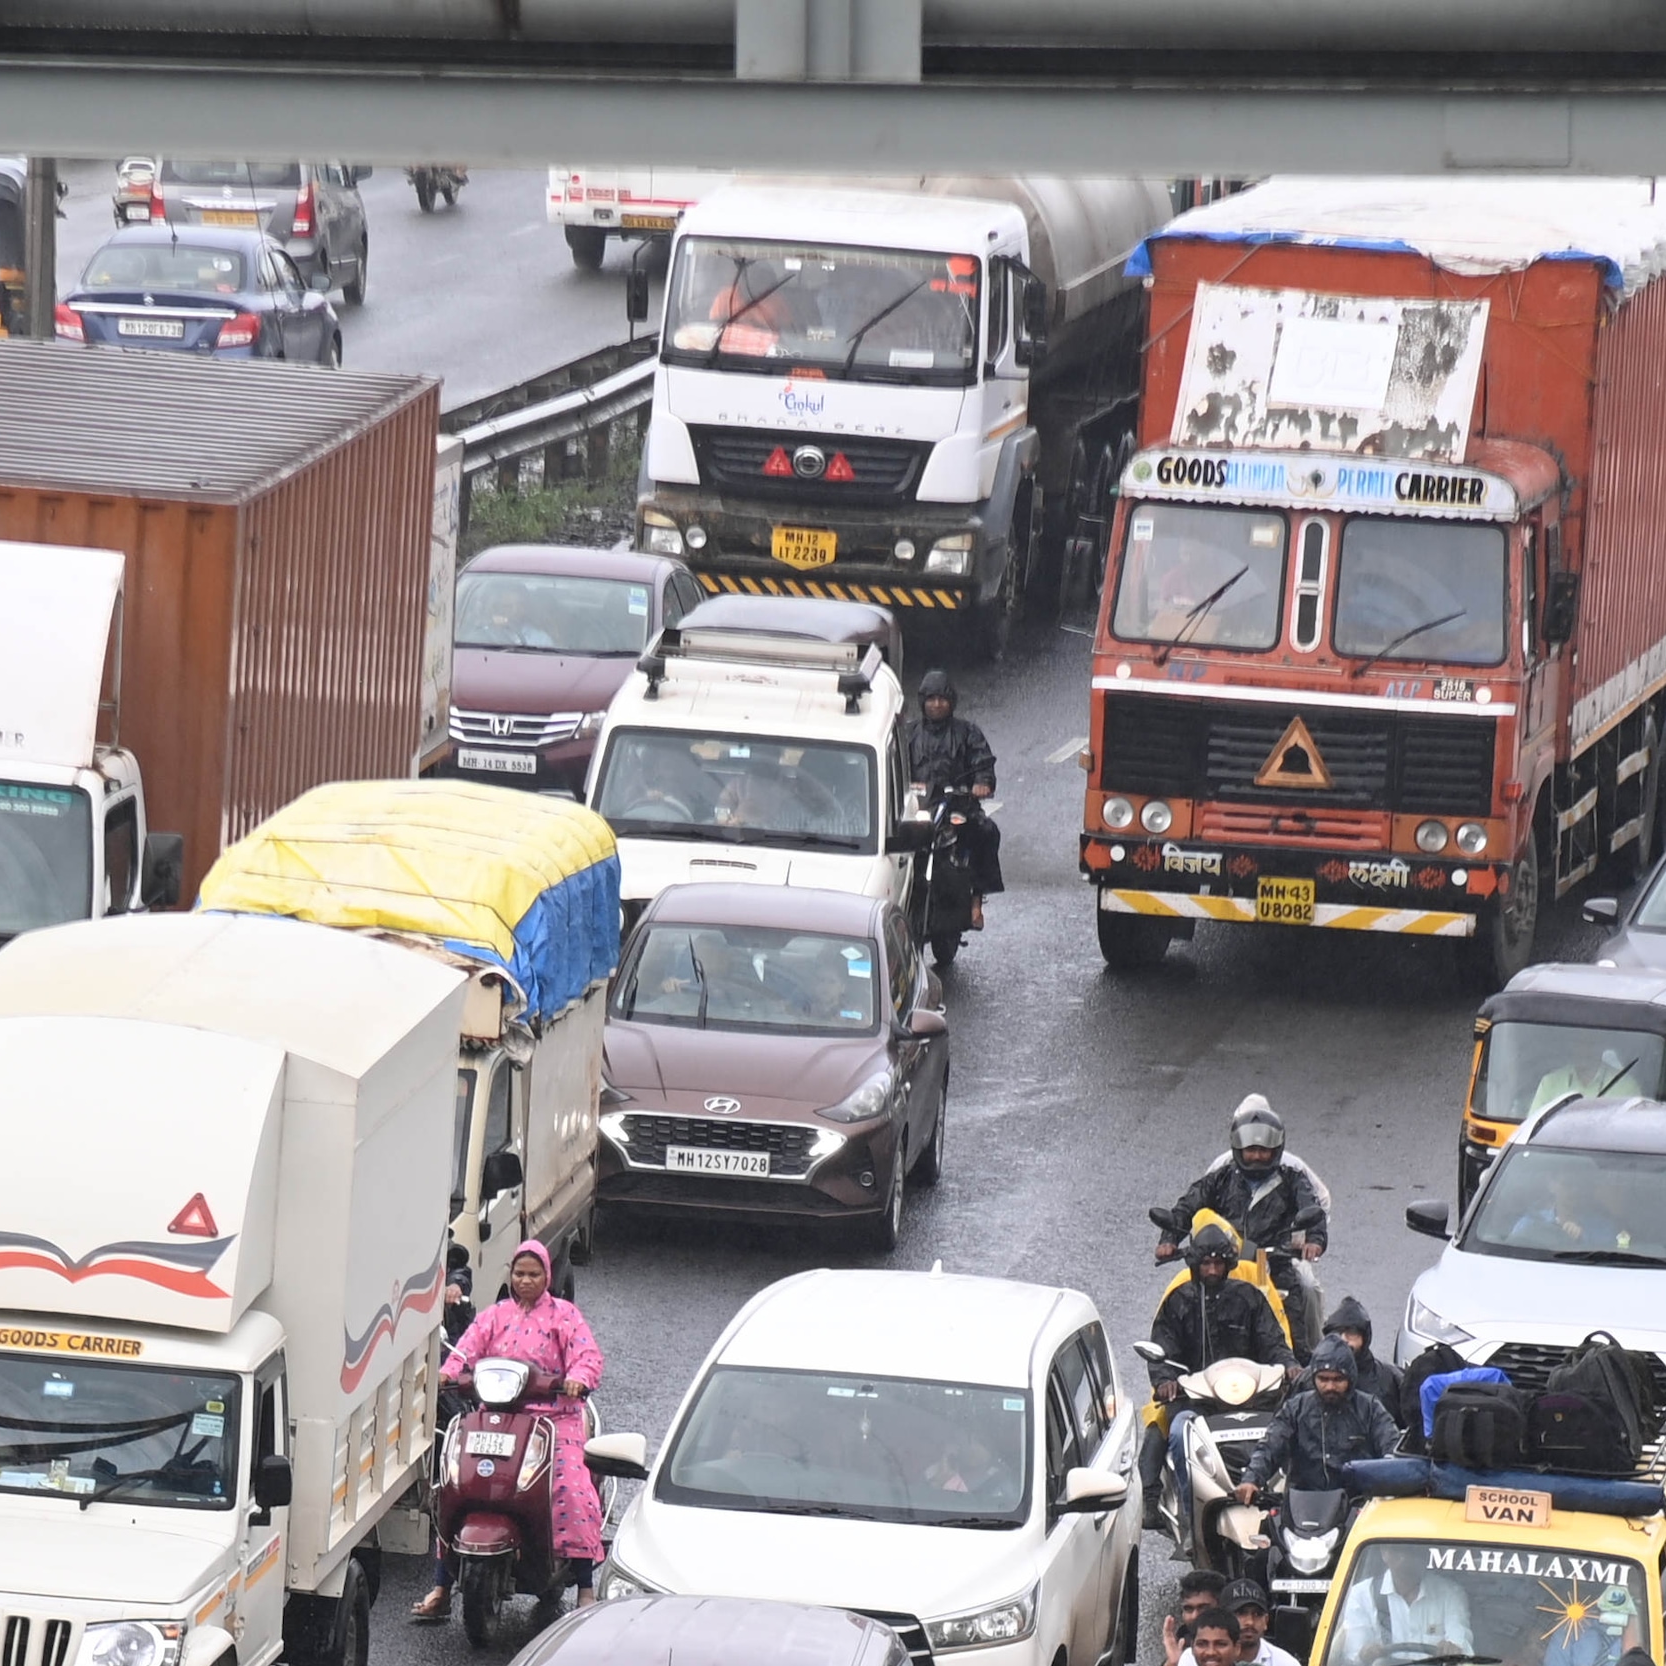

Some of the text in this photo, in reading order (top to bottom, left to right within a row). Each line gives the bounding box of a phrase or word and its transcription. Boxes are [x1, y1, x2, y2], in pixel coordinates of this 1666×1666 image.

[1156, 457, 1228, 489] GOODS
[1394, 472, 1485, 506] CARRIER
[785, 530, 819, 547] MH 12
[793, 547, 827, 564] 2239
[1433, 689, 1472, 702] SUPER
[1161, 841, 1409, 893] विजय लक्ष्मी
[677, 1152, 768, 1174] MH12SY7028
[66, 1334, 143, 1358] CARRIER
[1478, 1491, 1539, 1507] SCHOOL
[1481, 1504, 1535, 1526] VAN
[1426, 1545, 1632, 1588] MAHALAXMI
